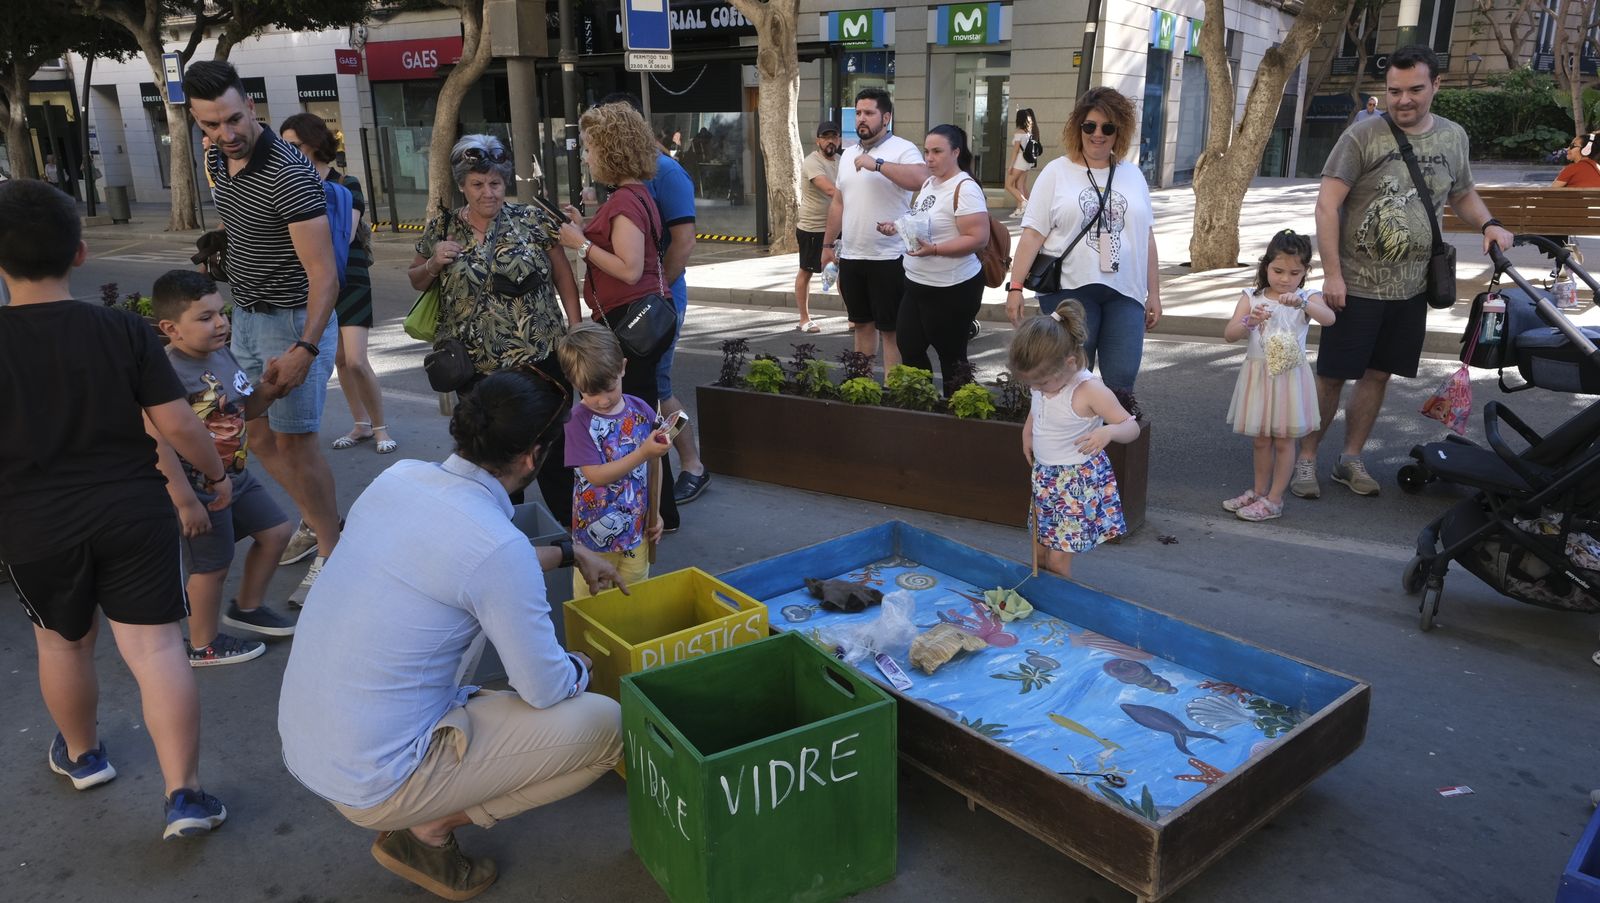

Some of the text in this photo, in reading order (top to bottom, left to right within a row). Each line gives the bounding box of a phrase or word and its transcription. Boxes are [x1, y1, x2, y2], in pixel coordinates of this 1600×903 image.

[616, 9, 706, 33] IRIAL
[953, 33, 982, 41] movistar
[339, 56, 358, 65] GAES
[402, 49, 438, 69] GAES
[299, 89, 336, 98] CORTEFIEL
[720, 732, 860, 816] VIDRE
[627, 729, 691, 841] VIDRE
